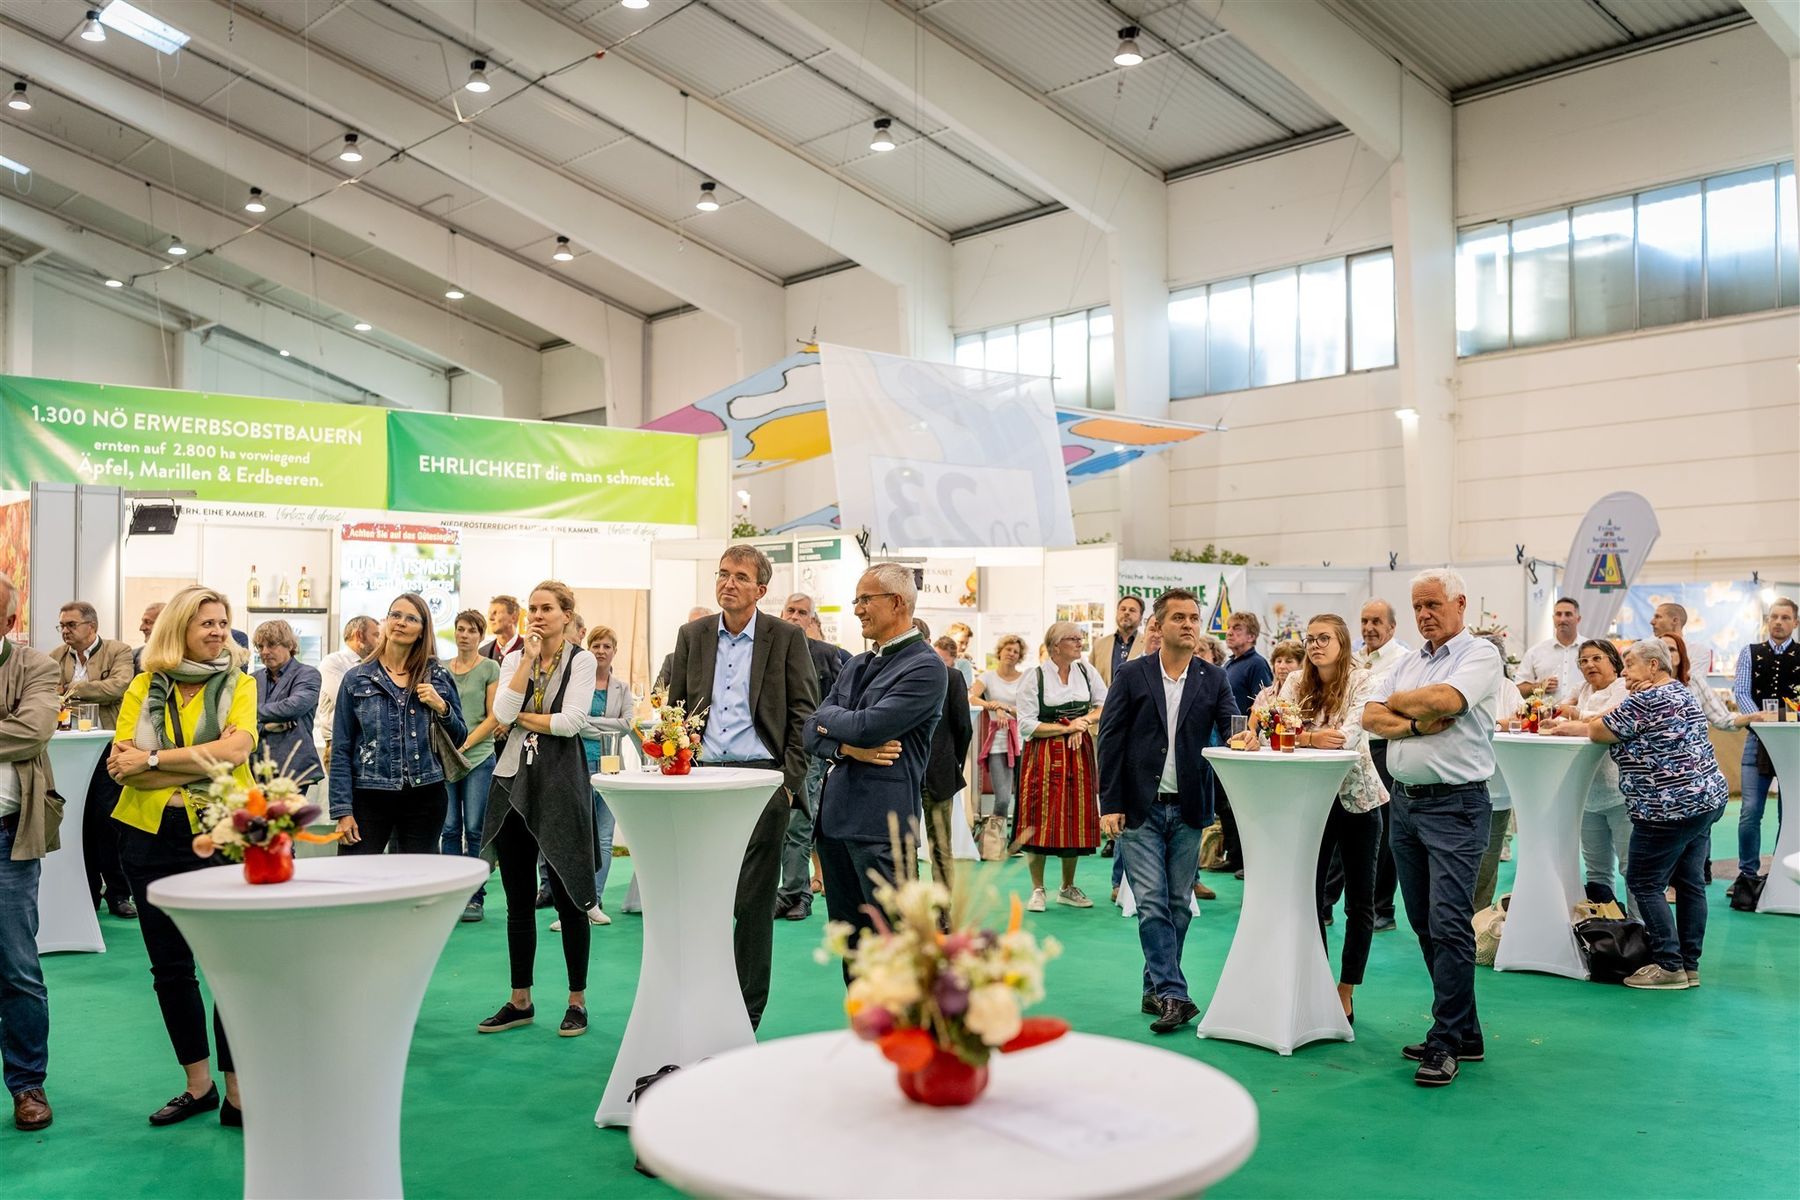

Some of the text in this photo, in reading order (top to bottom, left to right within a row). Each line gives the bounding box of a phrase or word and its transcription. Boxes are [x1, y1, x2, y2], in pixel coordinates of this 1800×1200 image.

[31, 404, 363, 446] 1.300 NÖ ERWERBSOBSTBAUERN
[93, 440, 311, 468] ernten auf 2.800 ha vorwiegend
[76, 451, 325, 488] Äpfel, Marillen & Erdbeeren.
[418, 454, 676, 488] EHRLICHKEIT die man schmeckt.
[203, 508, 224, 517] EINE
[225, 509, 267, 519] KAMMER.
[390, 530, 402, 540] auf
[924, 584, 953, 594] BAU
